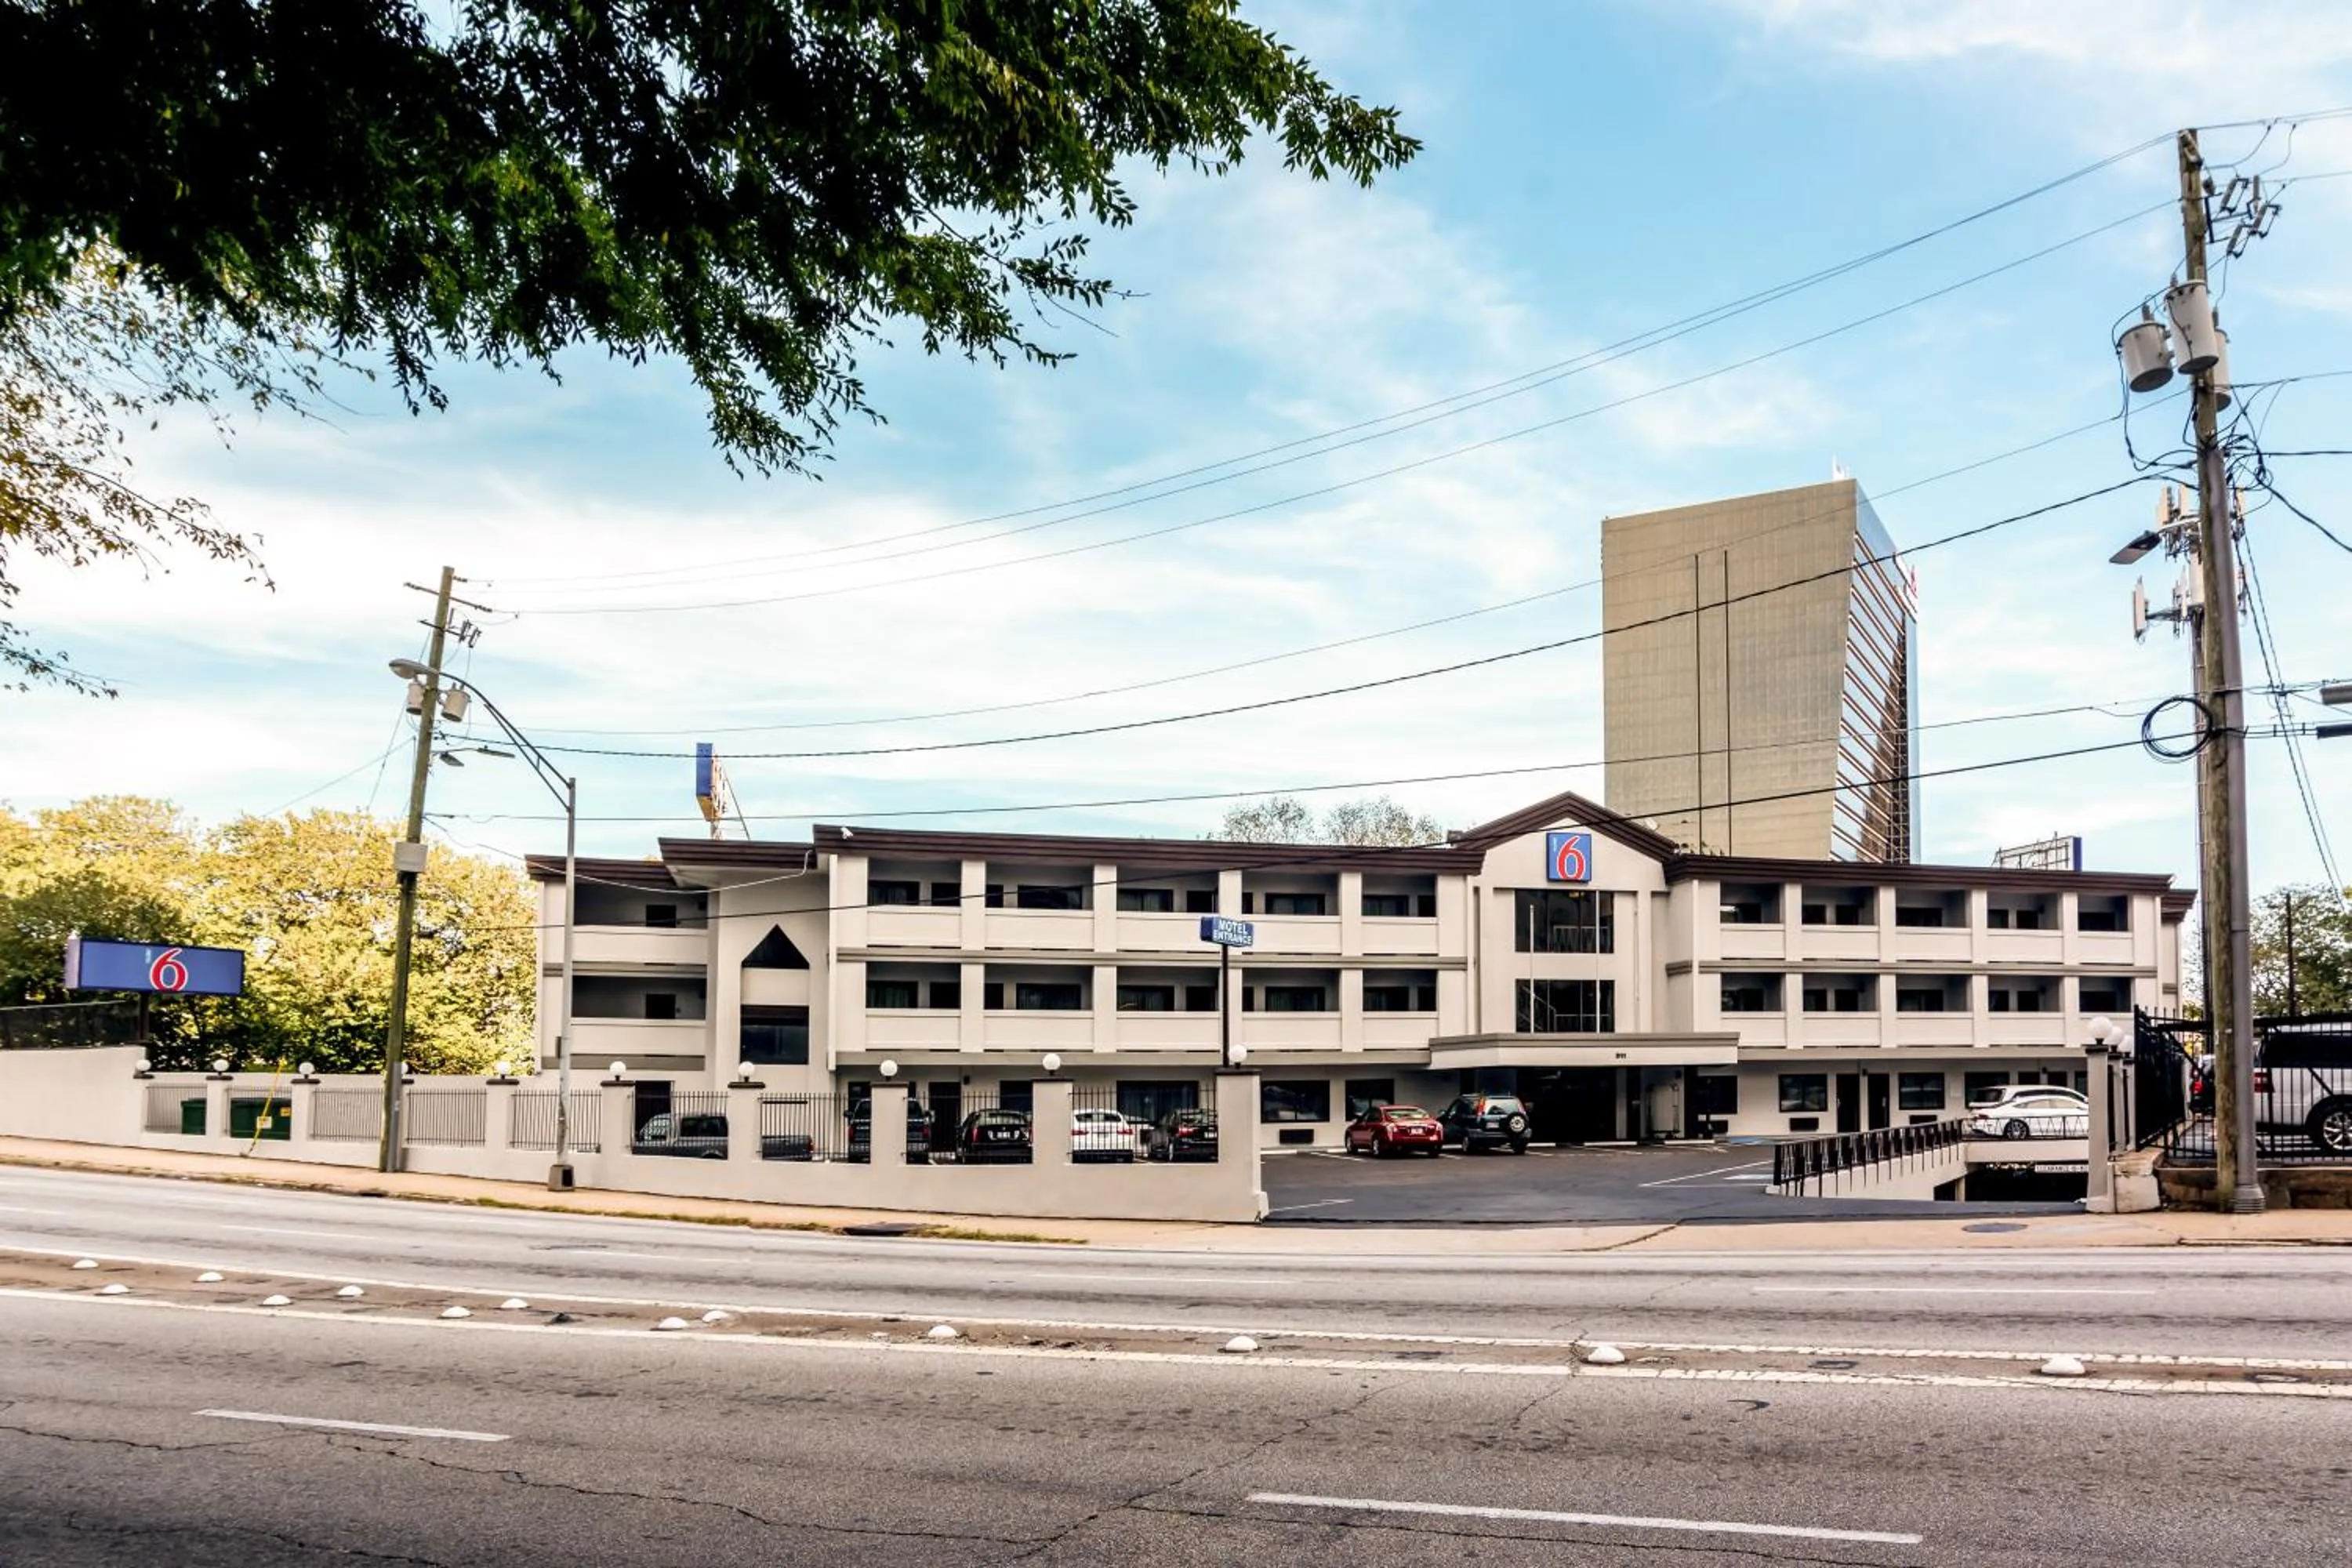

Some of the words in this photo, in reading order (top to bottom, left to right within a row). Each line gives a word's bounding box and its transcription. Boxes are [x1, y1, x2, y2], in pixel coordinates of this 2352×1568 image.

[1556, 835, 1586, 880] 6
[1212, 929, 1252, 945] ENTRANCE
[1218, 919, 1248, 935] MOTEL
[149, 947, 189, 992] 6
